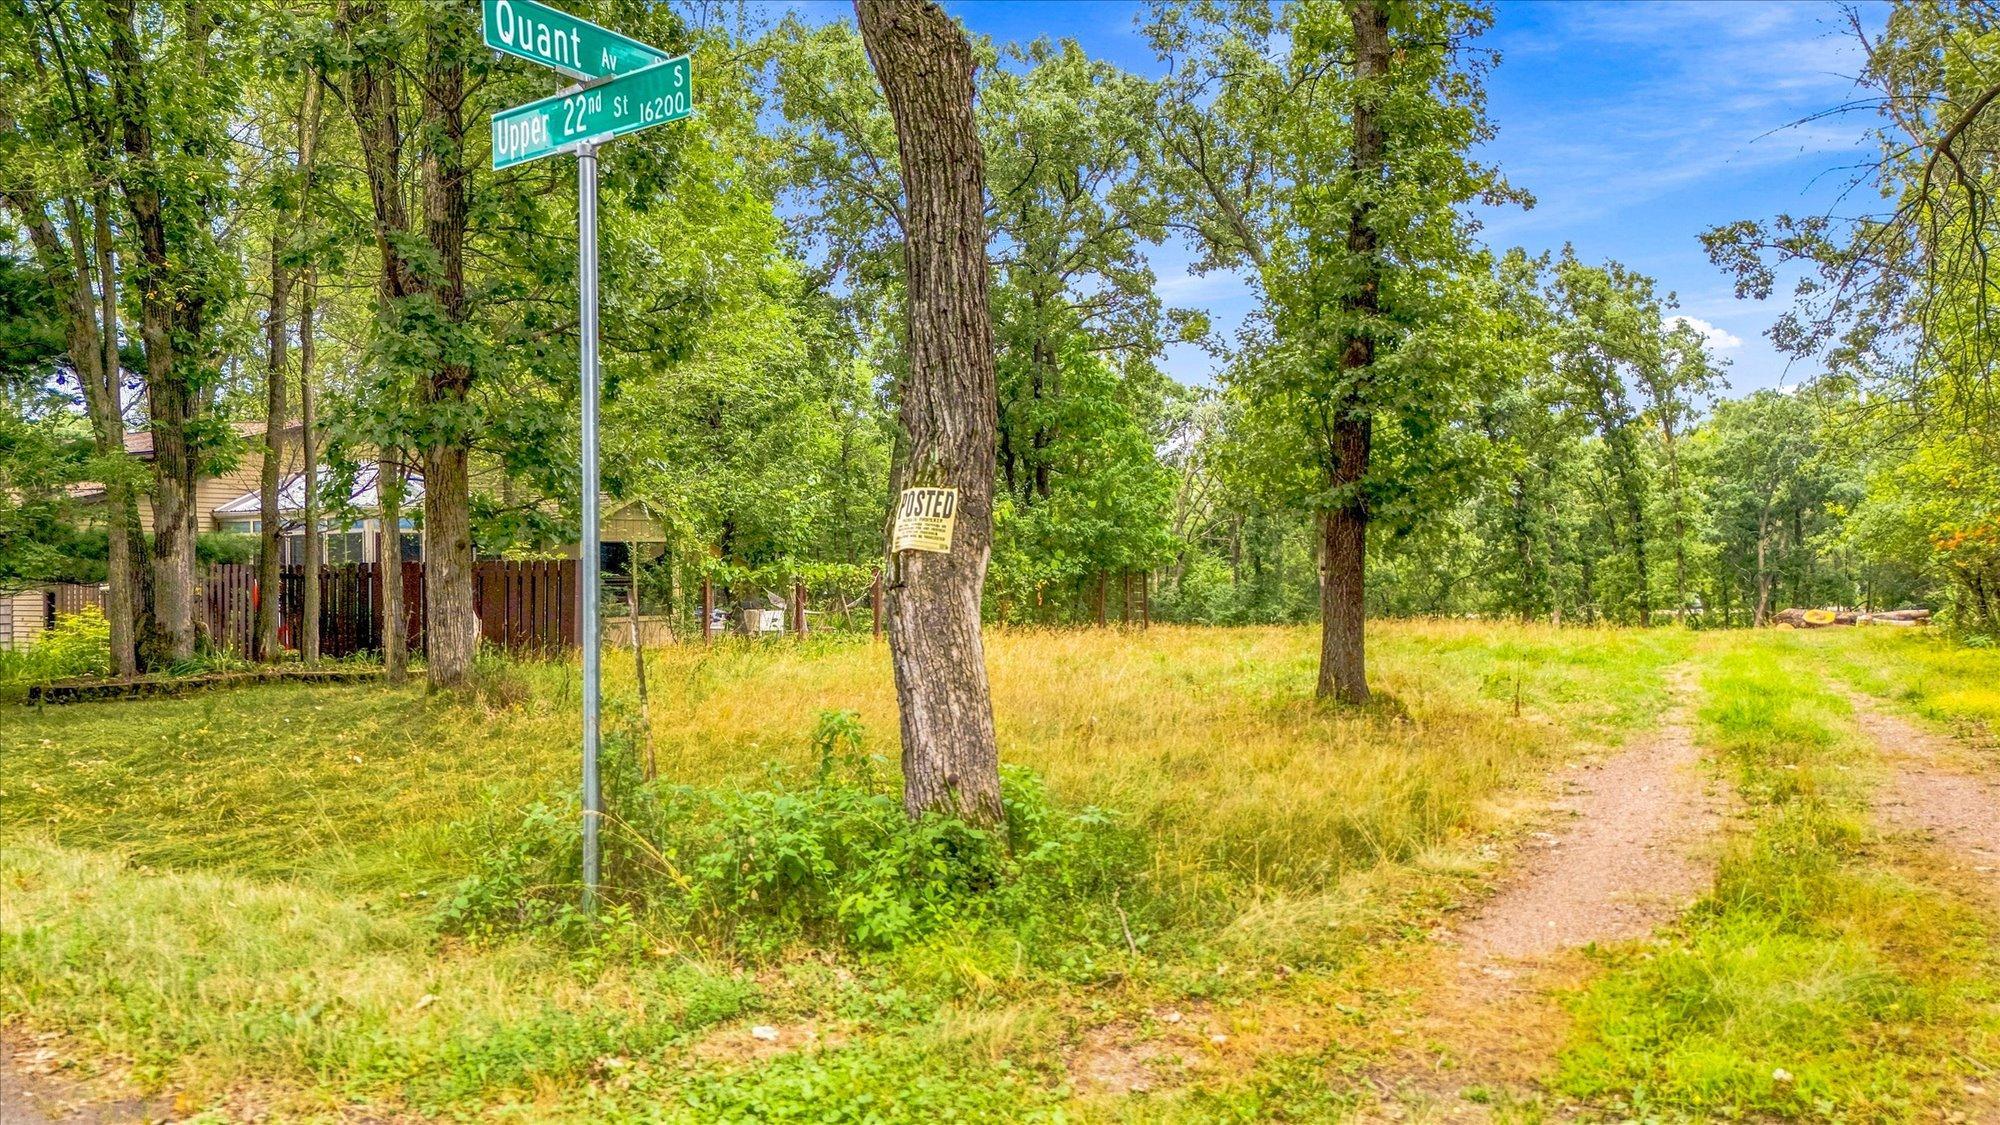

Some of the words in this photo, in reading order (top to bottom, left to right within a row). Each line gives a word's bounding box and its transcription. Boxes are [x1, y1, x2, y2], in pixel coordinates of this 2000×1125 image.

[496, 0, 581, 68] Quant
[601, 47, 617, 71] Av
[673, 65, 683, 88] S
[639, 91, 684, 123] 16200
[497, 114, 549, 160] Upper
[563, 91, 602, 136] 22nd
[613, 94, 629, 117] St
[898, 490, 954, 519] POSTED
